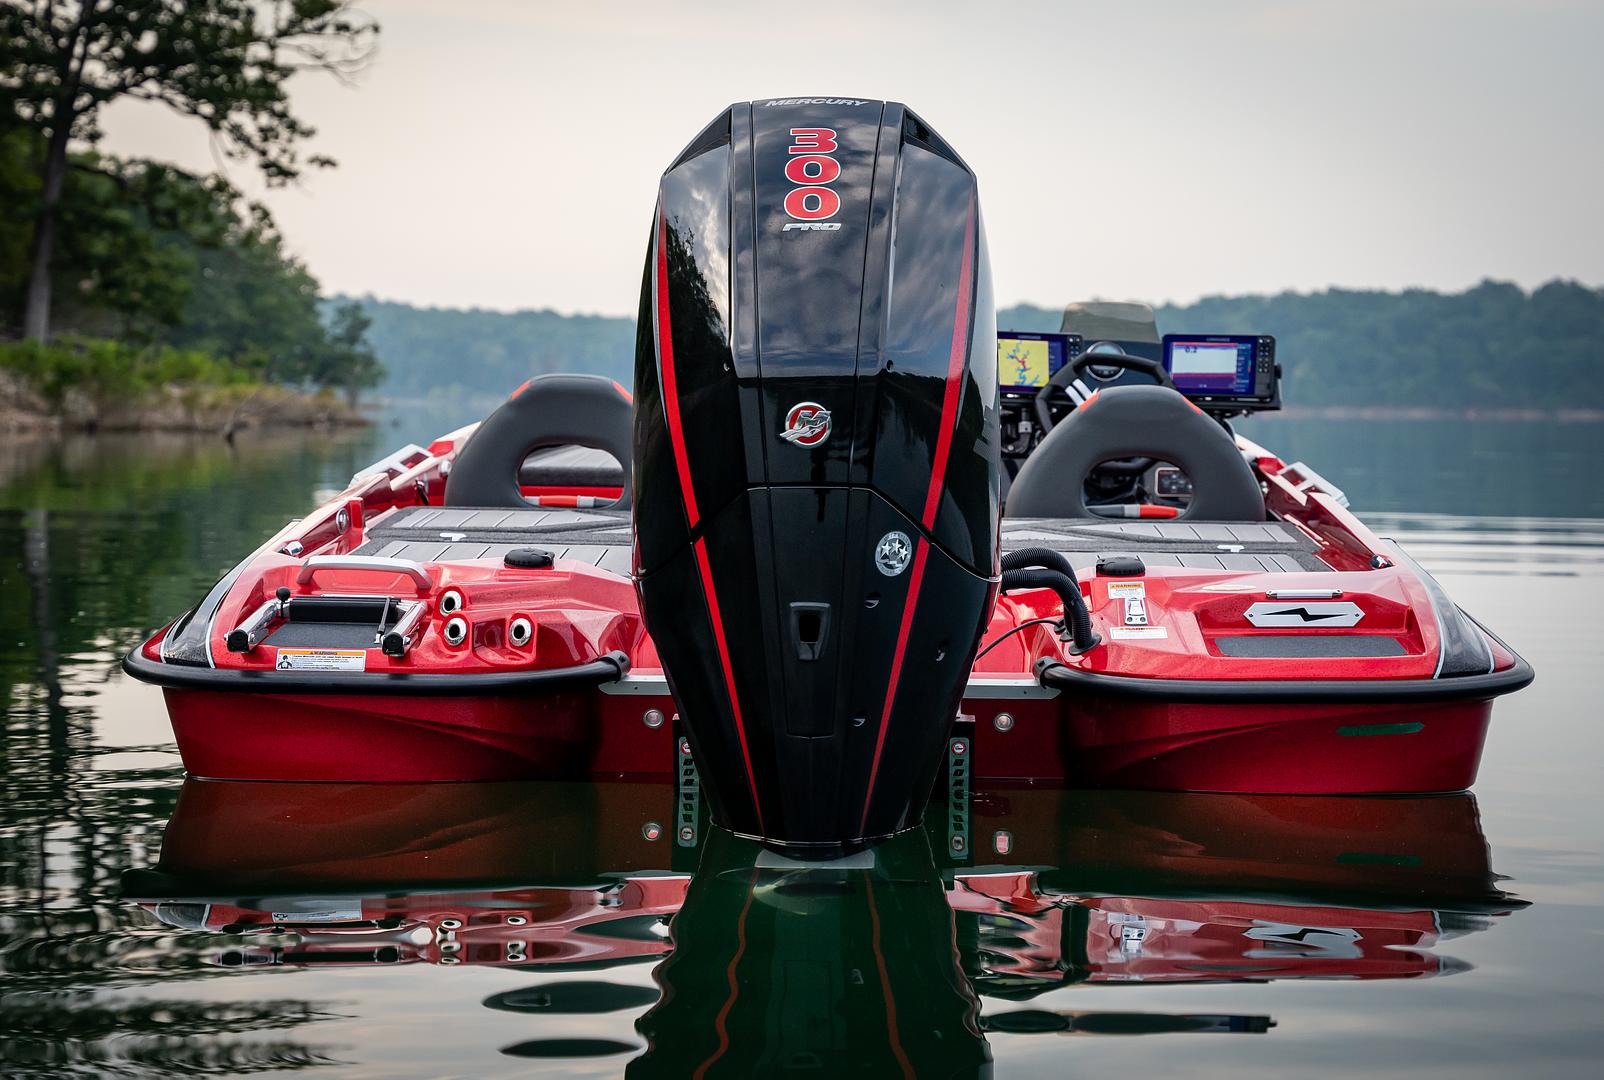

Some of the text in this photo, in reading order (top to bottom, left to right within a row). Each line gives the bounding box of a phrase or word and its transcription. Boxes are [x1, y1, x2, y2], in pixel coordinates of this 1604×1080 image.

[765, 98, 869, 107] MERCURY
[784, 128, 841, 221] 300
[782, 223, 842, 232] PRO
